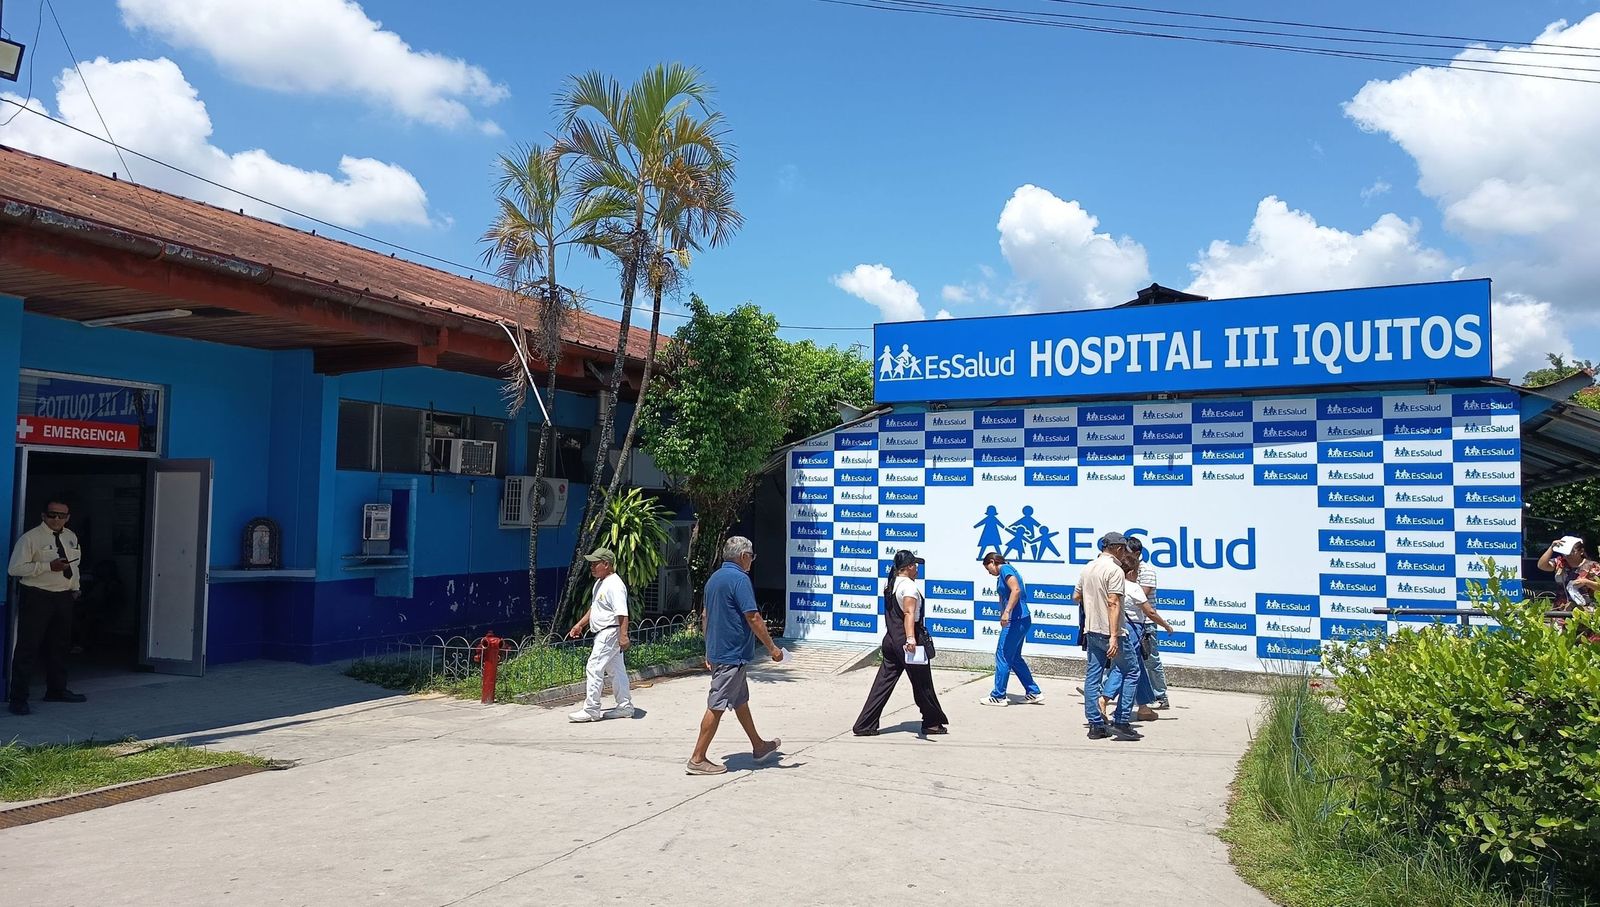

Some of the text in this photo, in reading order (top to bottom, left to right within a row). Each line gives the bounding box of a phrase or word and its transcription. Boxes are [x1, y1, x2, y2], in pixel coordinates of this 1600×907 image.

[1030, 314, 1482, 377] HOSPITAL III IQUITOS
[924, 350, 1015, 380] EsSalud
[43, 425, 125, 442] EMERGENCIA
[1411, 449, 1442, 457] EsSalud
[1482, 471, 1514, 479] EsSalud
[1345, 494, 1374, 502] EsSalud
[1345, 516, 1374, 524] EsSalud
[1483, 518, 1516, 526] EsSalud
[1413, 540, 1444, 548] EsSalud
[1346, 561, 1375, 569] EsSalud
[1414, 563, 1444, 571] EsSalud
[1346, 583, 1376, 591] EsSalud
[1047, 592, 1071, 600] EsSalud
[1281, 603, 1310, 611] EsSalud
[1219, 622, 1246, 630] EsSalud
[1282, 625, 1310, 633] EsSalud
